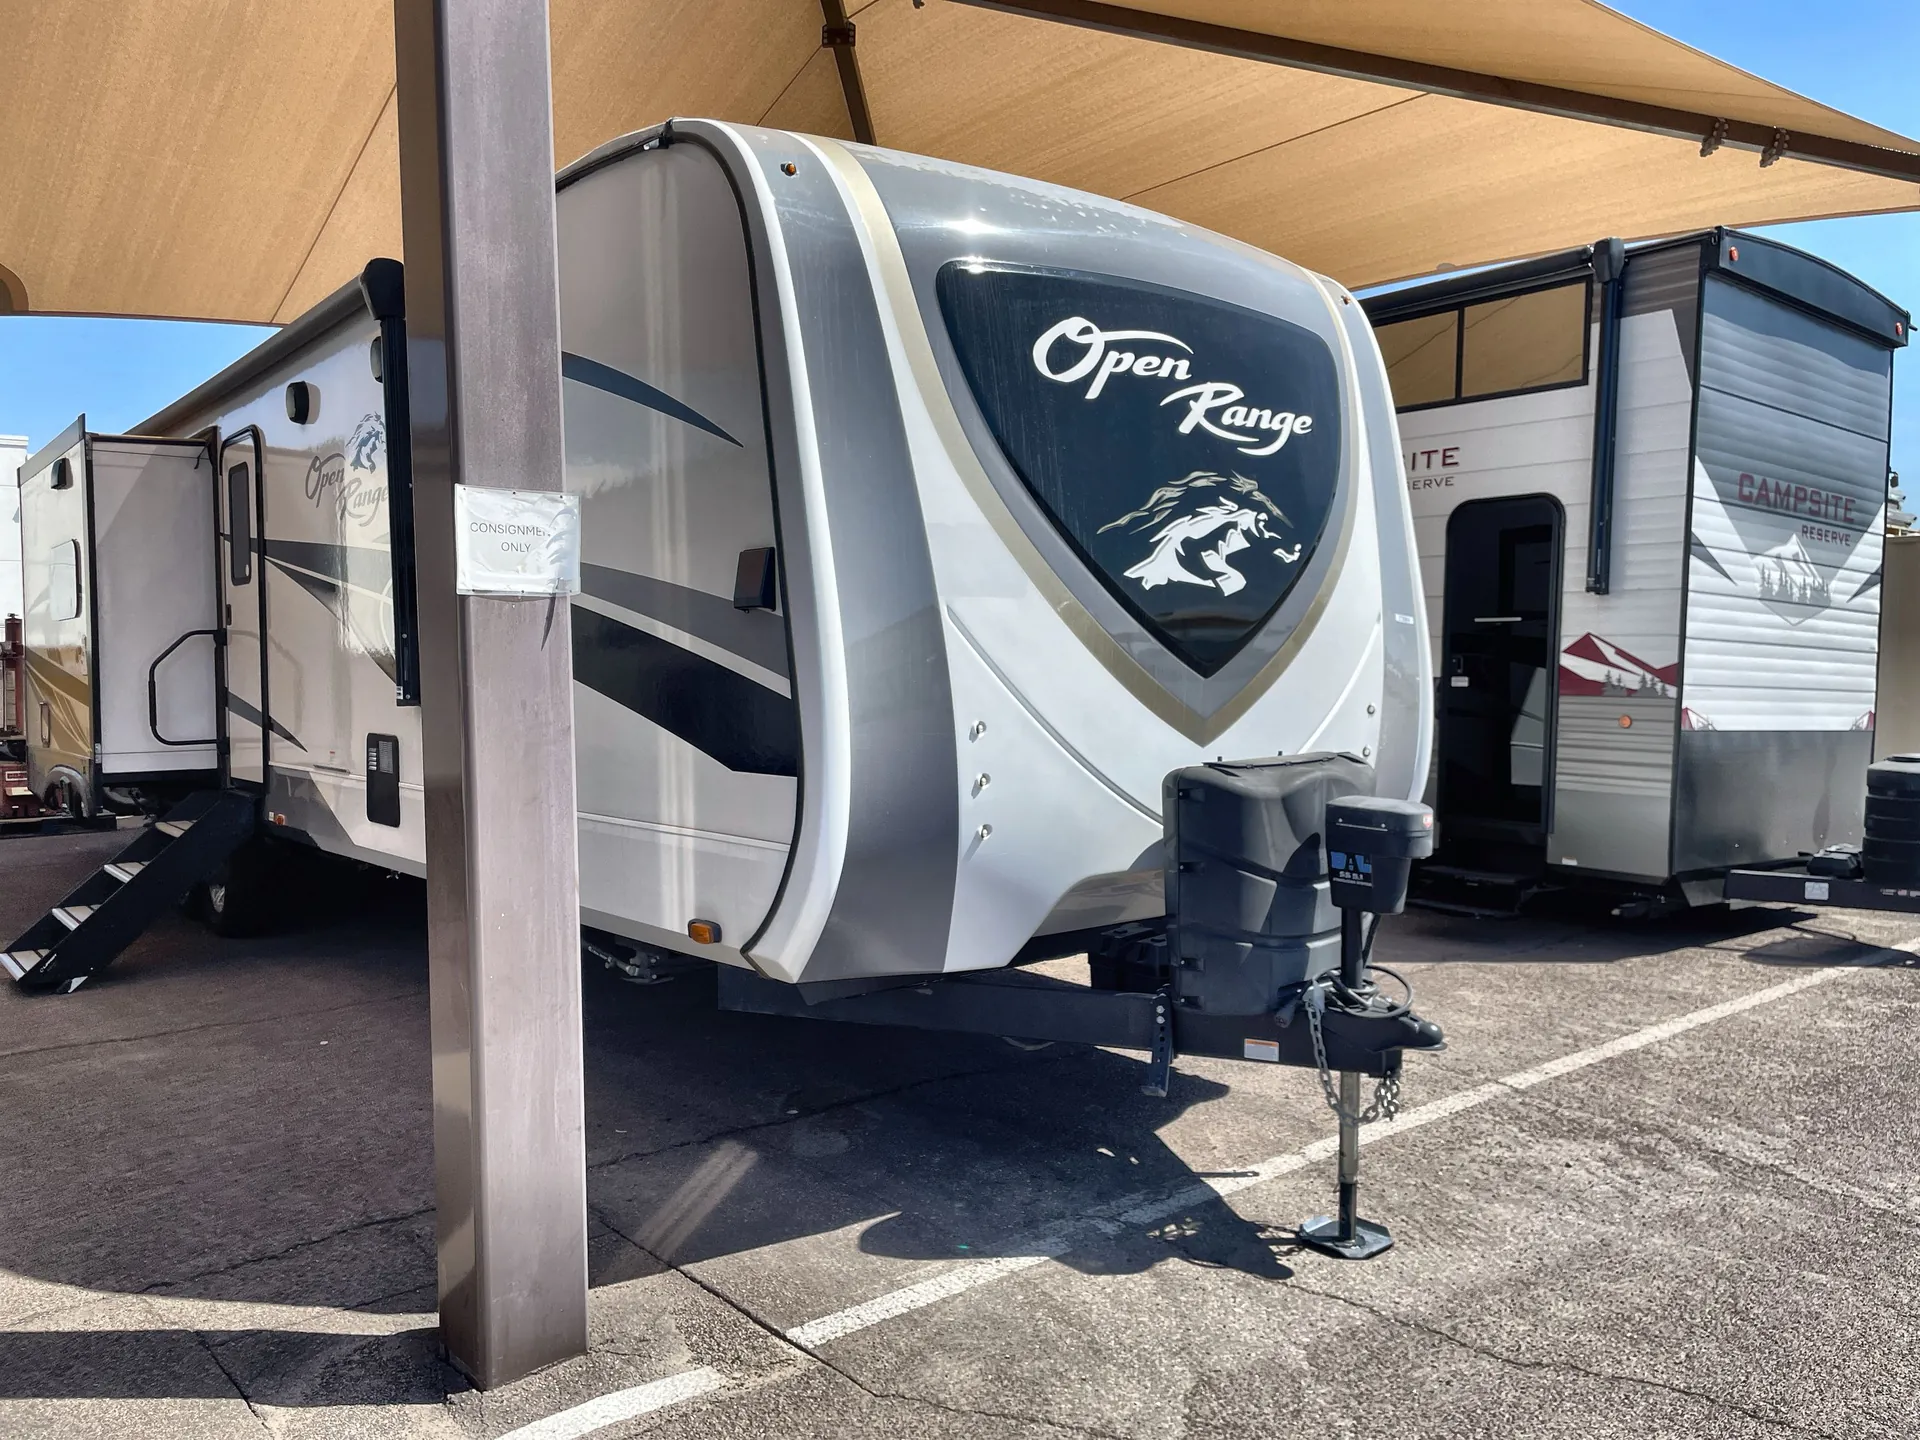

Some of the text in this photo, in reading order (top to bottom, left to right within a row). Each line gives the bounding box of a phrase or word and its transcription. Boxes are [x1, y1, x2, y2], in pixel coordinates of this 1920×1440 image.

[1033, 317, 1194, 399] Open
[1160, 382, 1313, 456] Range
[305, 452, 346, 508] Open
[1402, 446, 1460, 471] ITE
[1738, 472, 1856, 523] CAMPSITE
[501, 541, 531, 553] ONLY
[1801, 524, 1851, 546] RESERVE
